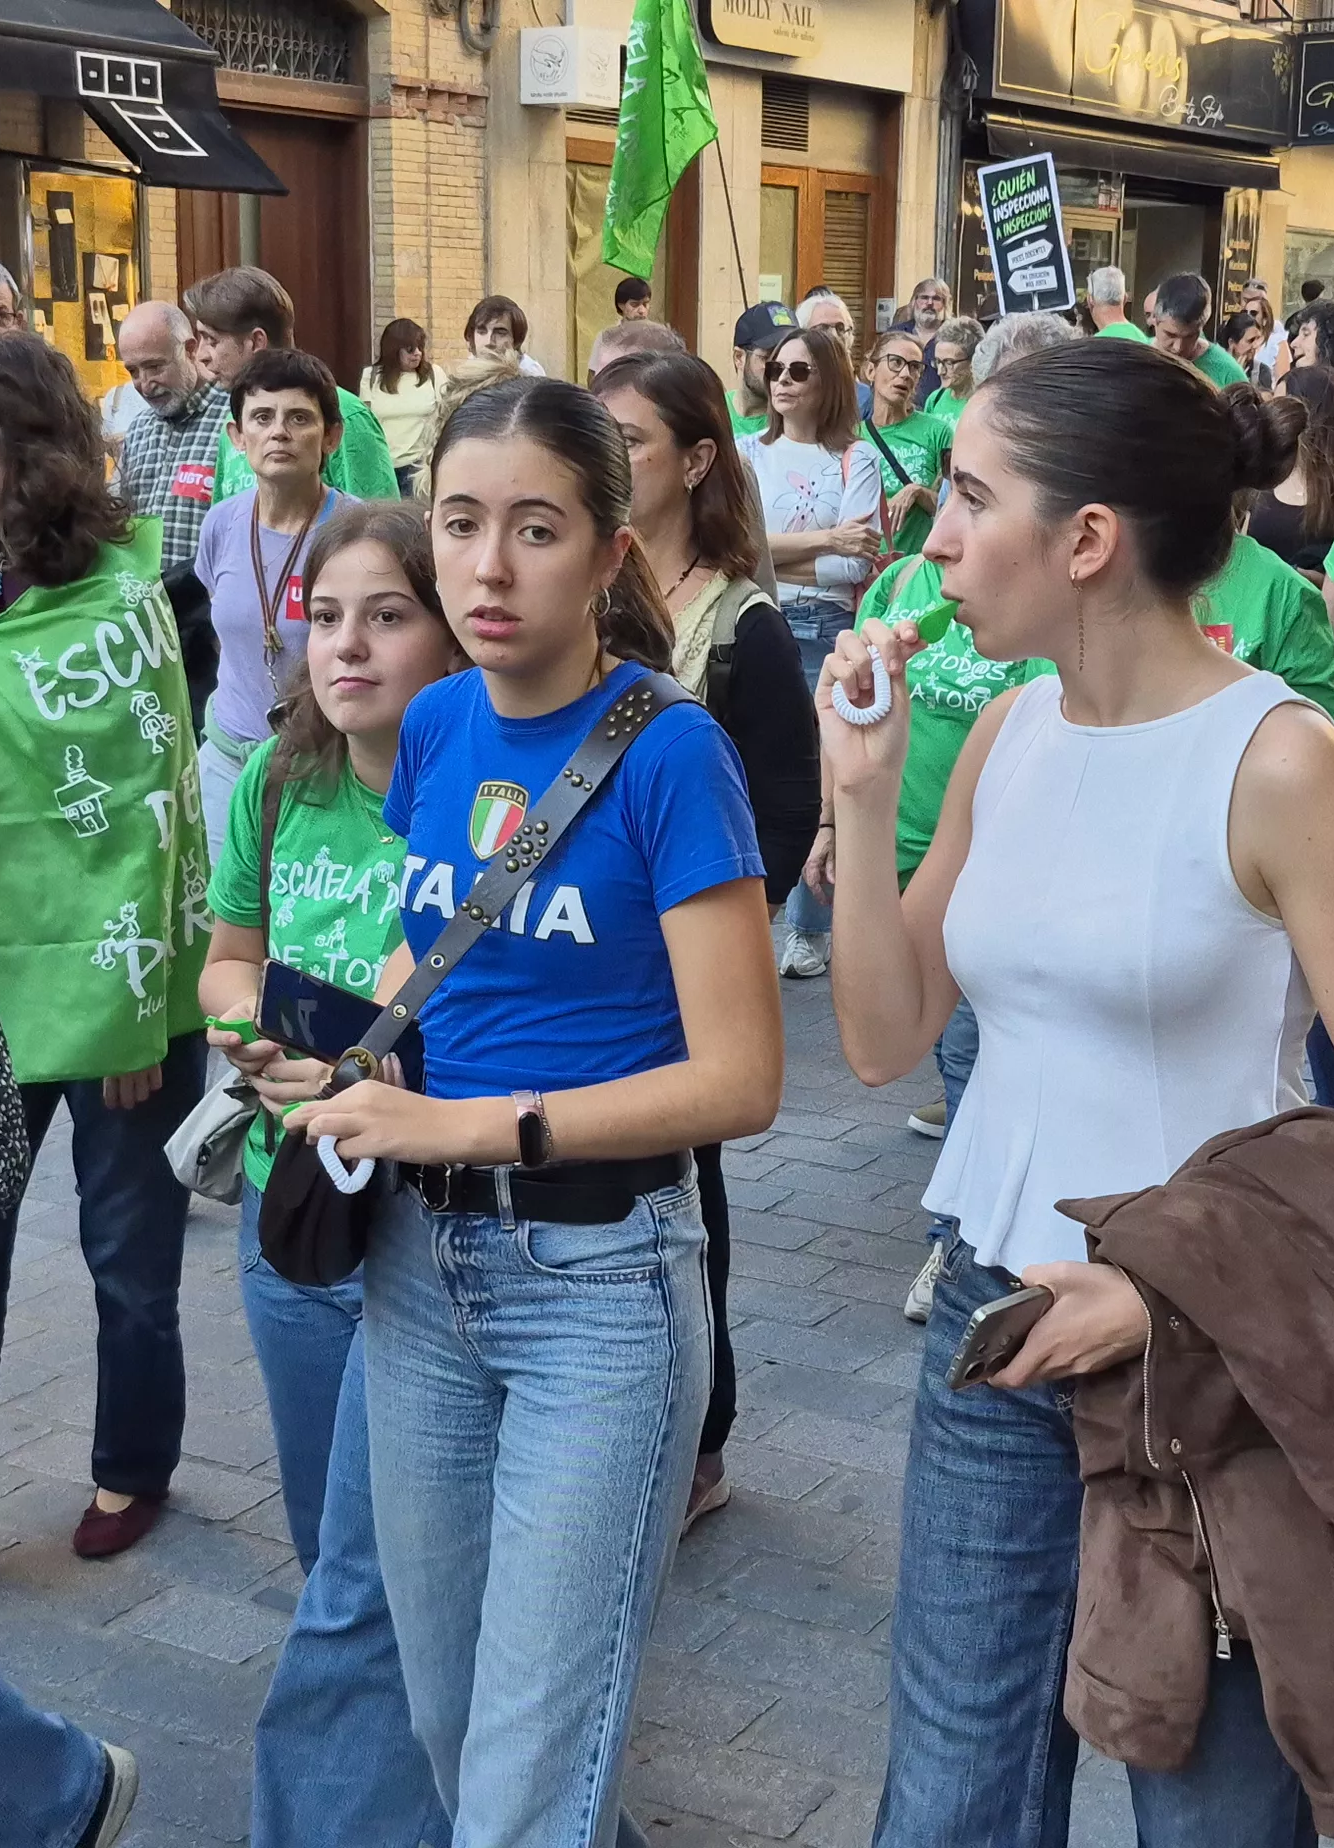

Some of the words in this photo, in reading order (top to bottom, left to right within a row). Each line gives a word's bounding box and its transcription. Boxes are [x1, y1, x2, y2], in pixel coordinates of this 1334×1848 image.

[782, 3, 815, 28] NAIL
[992, 165, 1036, 206] ¿QUIÉN
[993, 186, 1050, 223] INSPECCIONA
[996, 227, 1002, 241] A
[1003, 203, 1052, 237] INSPECCIÓN?
[179, 472, 203, 485] UGT
[928, 651, 1008, 681] TOD@S
[482, 784, 525, 806] ITALIA
